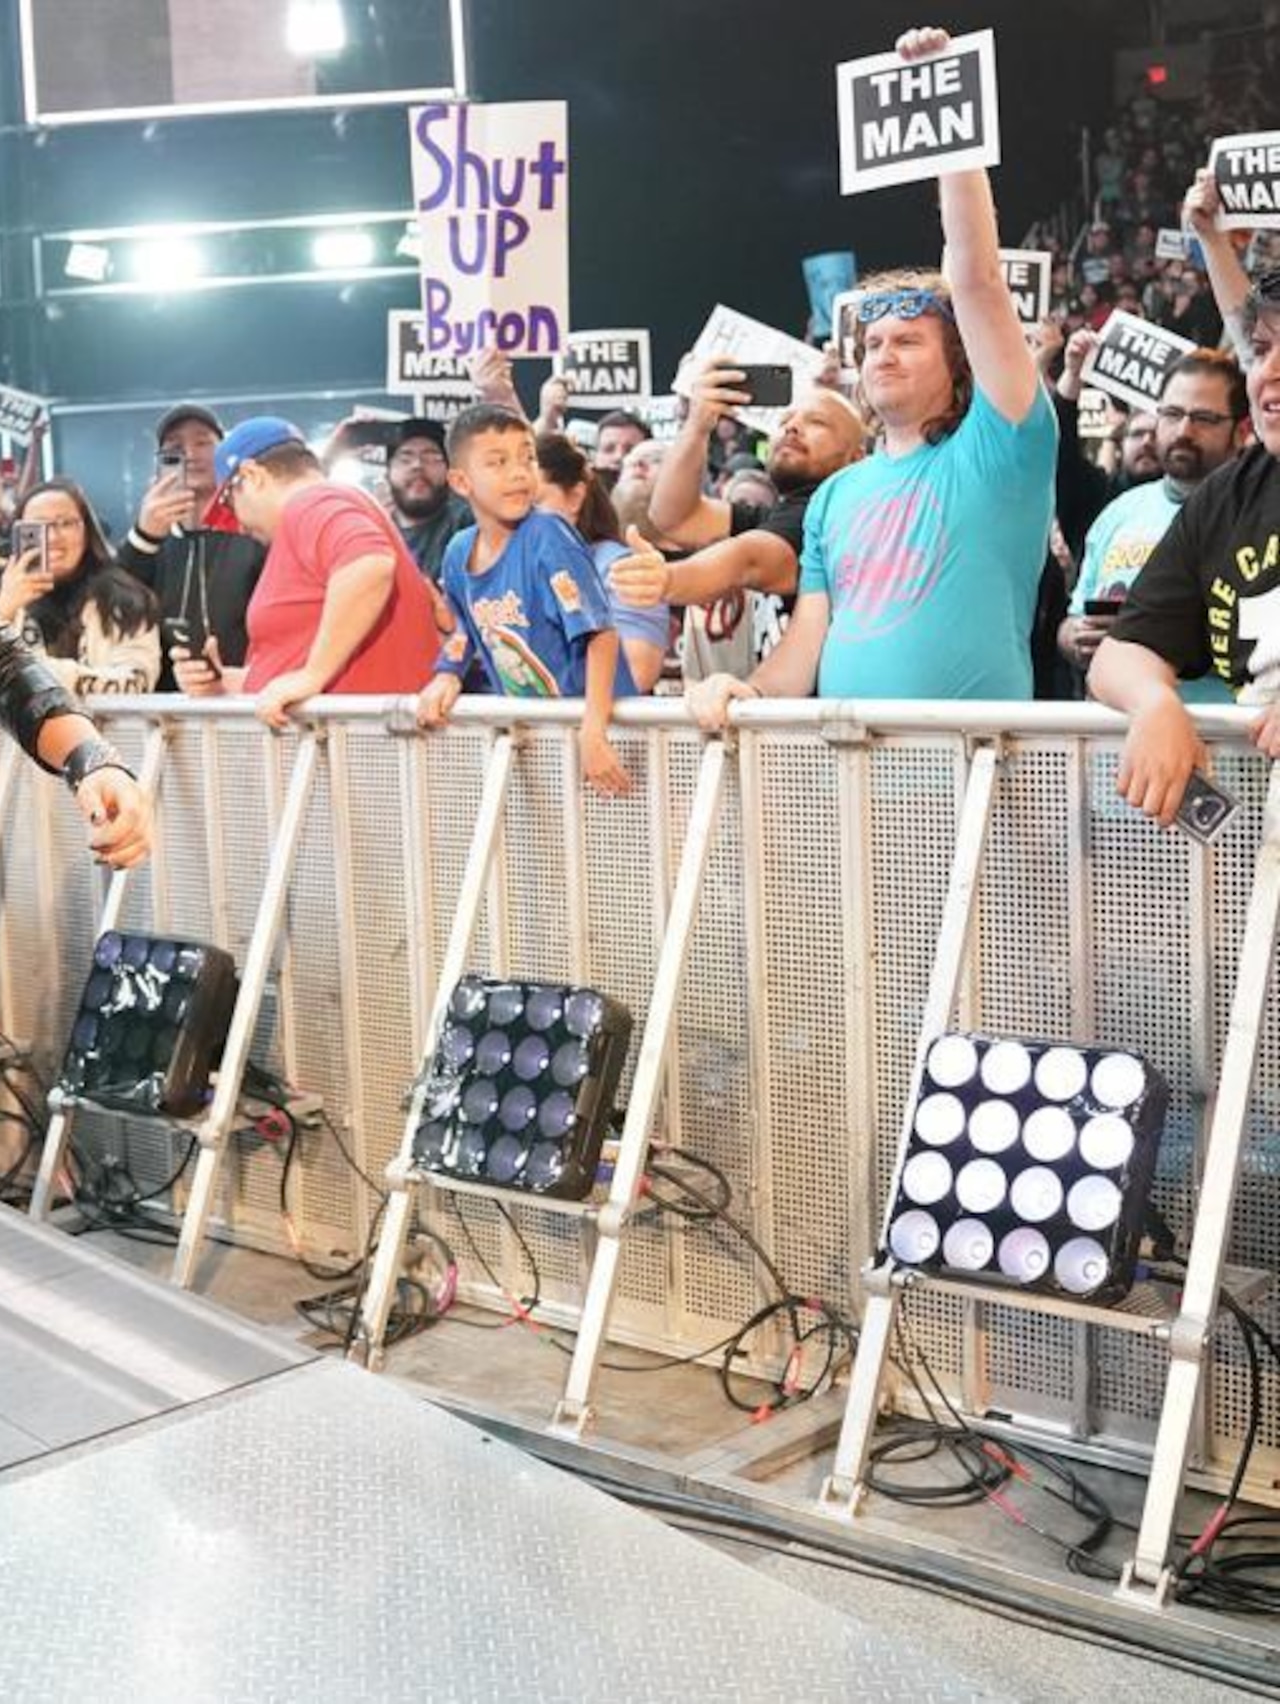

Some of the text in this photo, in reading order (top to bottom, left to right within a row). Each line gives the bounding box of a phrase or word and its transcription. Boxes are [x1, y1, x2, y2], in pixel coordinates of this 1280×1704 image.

[870, 58, 963, 107] THE
[415, 101, 565, 211] Shut
[862, 102, 975, 161] MAN
[1226, 147, 1280, 177] THE
[425, 278, 560, 356] Byron
[573, 341, 630, 363] THE
[1117, 324, 1173, 366] THE
[564, 367, 638, 392] MAN
[1098, 347, 1165, 397] MAN
[1, 391, 37, 418] THE
[1208, 575, 1240, 684] HERE
